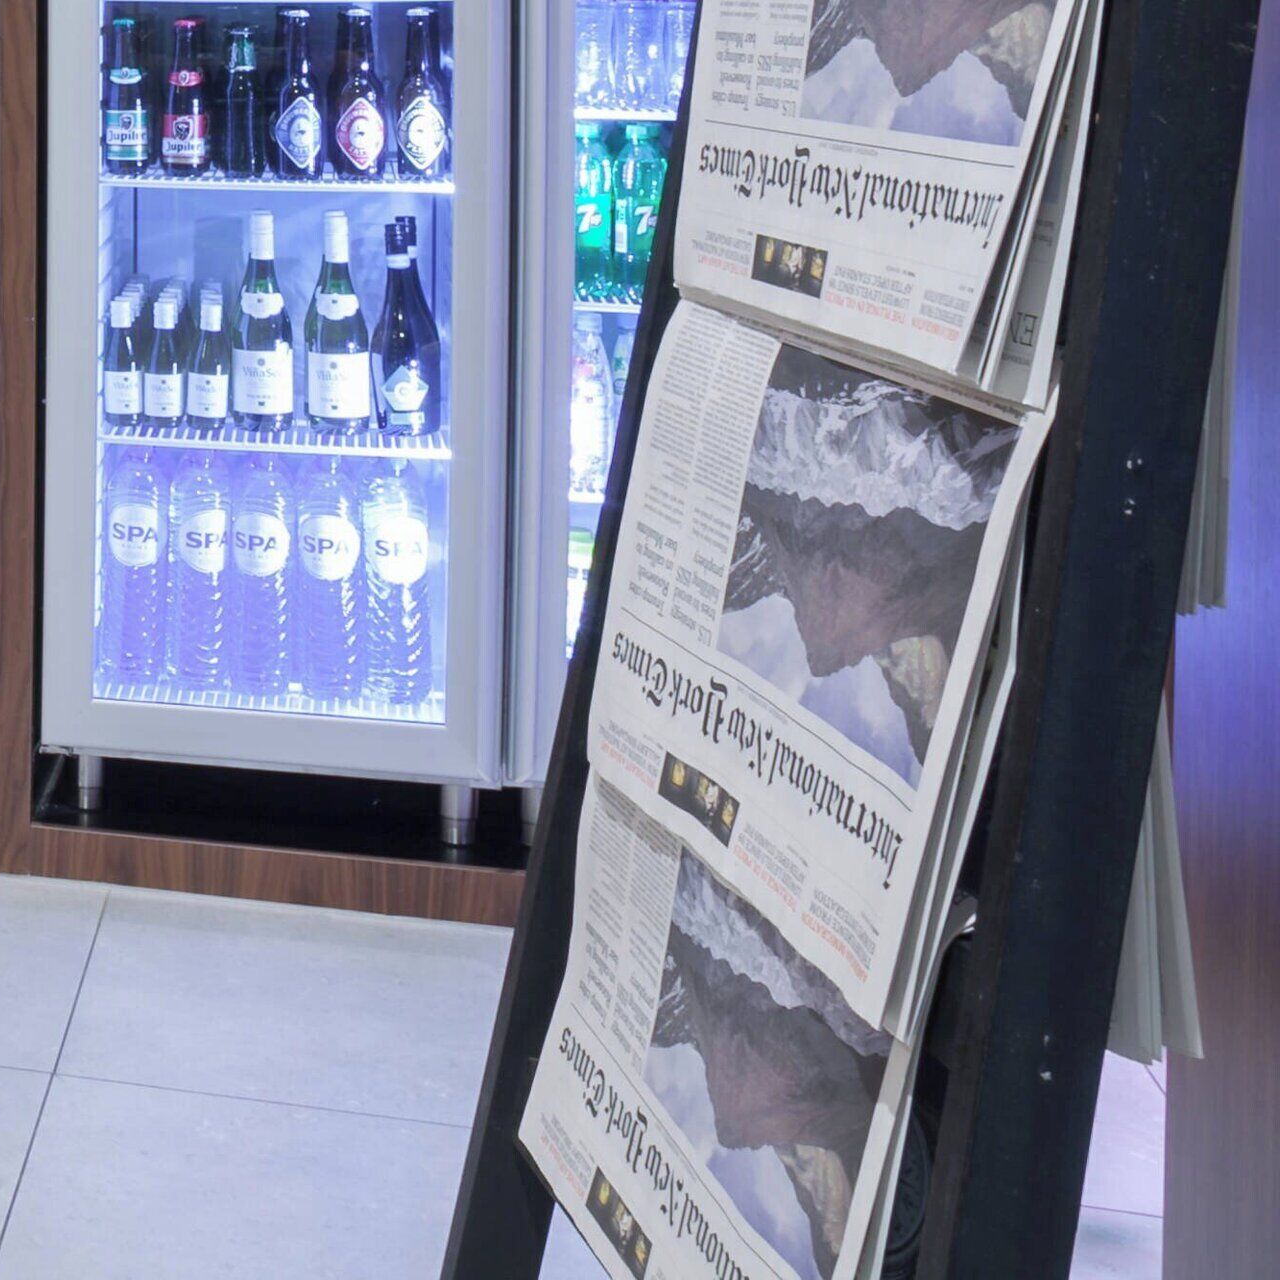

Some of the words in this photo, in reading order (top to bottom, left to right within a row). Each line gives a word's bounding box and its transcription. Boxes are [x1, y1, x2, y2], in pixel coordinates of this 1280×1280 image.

[166, 140, 203, 154] Jupiler
[699, 144, 756, 198] Times
[757, 146, 810, 208] York
[810, 163, 861, 220] New
[857, 172, 1004, 249] International
[112, 522, 158, 543] SPA
[235, 532, 277, 551] SPA
[303, 535, 349, 554] SPA
[612, 632, 668, 707] Times
[669, 670, 728, 744] York
[728, 707, 773, 778] New
[768, 738, 903, 890] International
[559, 1027, 605, 1118] Times
[605, 1086, 648, 1174] York
[645, 1144, 683, 1226] New
